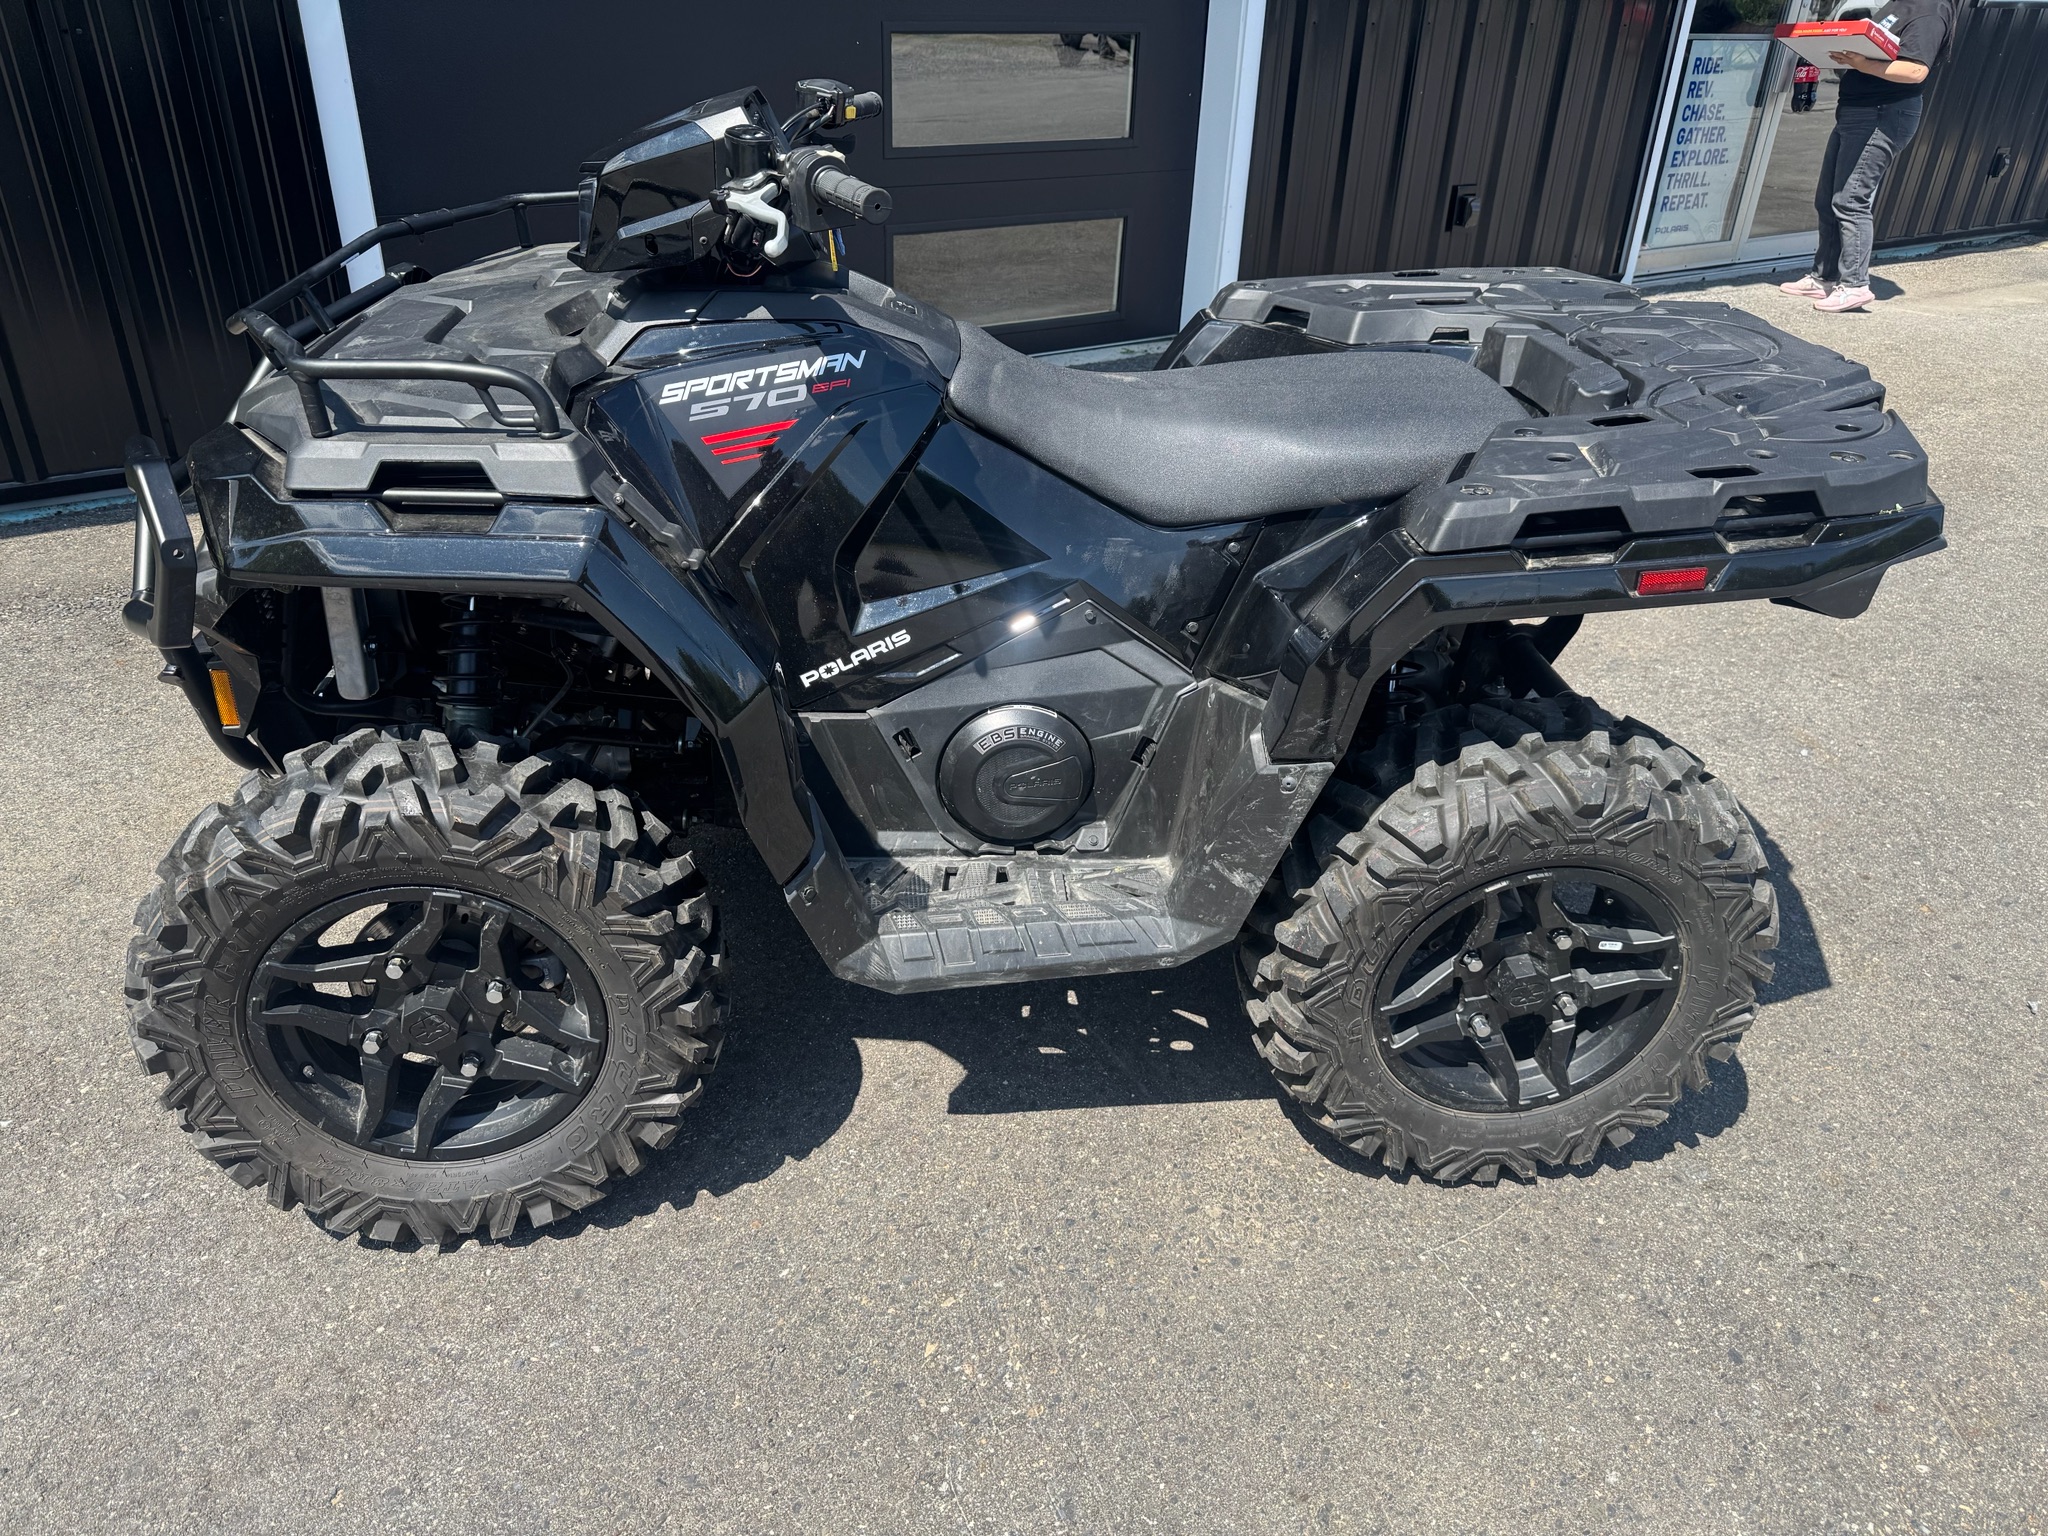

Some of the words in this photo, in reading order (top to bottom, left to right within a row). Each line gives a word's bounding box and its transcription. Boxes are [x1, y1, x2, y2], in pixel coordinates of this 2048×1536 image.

[1692, 57, 1724, 75] RIDE.
[1687, 80, 1714, 98] REV.
[1682, 104, 1725, 122] CHASE.
[1676, 126, 1727, 145] GATHER.
[1670, 148, 1729, 168] EXPLORE.
[1666, 171, 1711, 190] THRILL.
[1660, 192, 1708, 212] REPEAT.
[1655, 224, 1689, 235] POLARIS
[659, 350, 867, 405] SPORTSMAN
[688, 384, 808, 422] 570
[811, 378, 852, 394] EFI
[800, 628, 912, 688] POLARIS
[978, 728, 1016, 751] EBS
[1019, 727, 1063, 747] ENGINE
[1009, 778, 1062, 791] POLARIS
